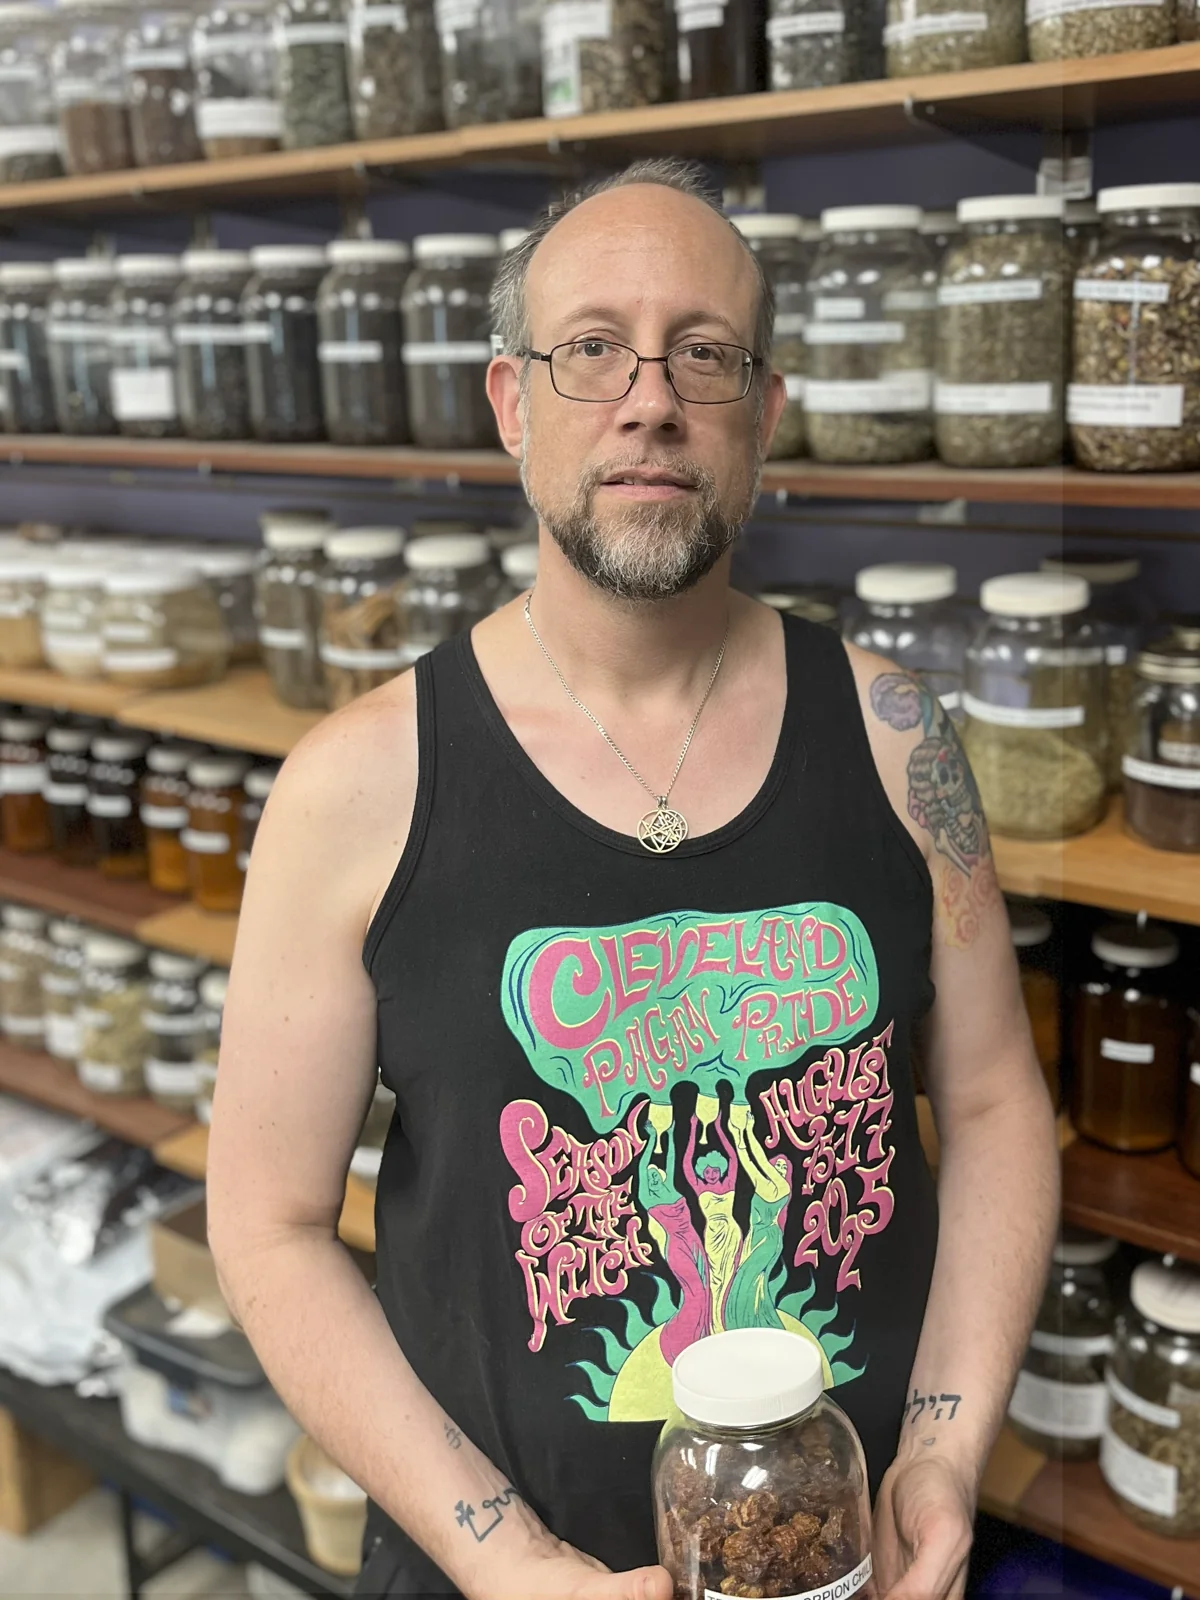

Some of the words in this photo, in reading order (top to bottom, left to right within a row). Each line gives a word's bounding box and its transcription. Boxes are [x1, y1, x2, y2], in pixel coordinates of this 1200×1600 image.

[528, 914, 848, 1050] CLEVELAND
[582, 986, 721, 1118] PAGAN
[731, 965, 869, 1062] PRIDE
[758, 1018, 894, 1150] AUGUST
[499, 1099, 651, 1223] SEASON
[520, 1205, 573, 1257] OF
[567, 1175, 638, 1240] THE
[794, 1145, 896, 1293] 2025
[514, 1215, 655, 1353] WITCH
[803, 1579, 850, 1600] PION
